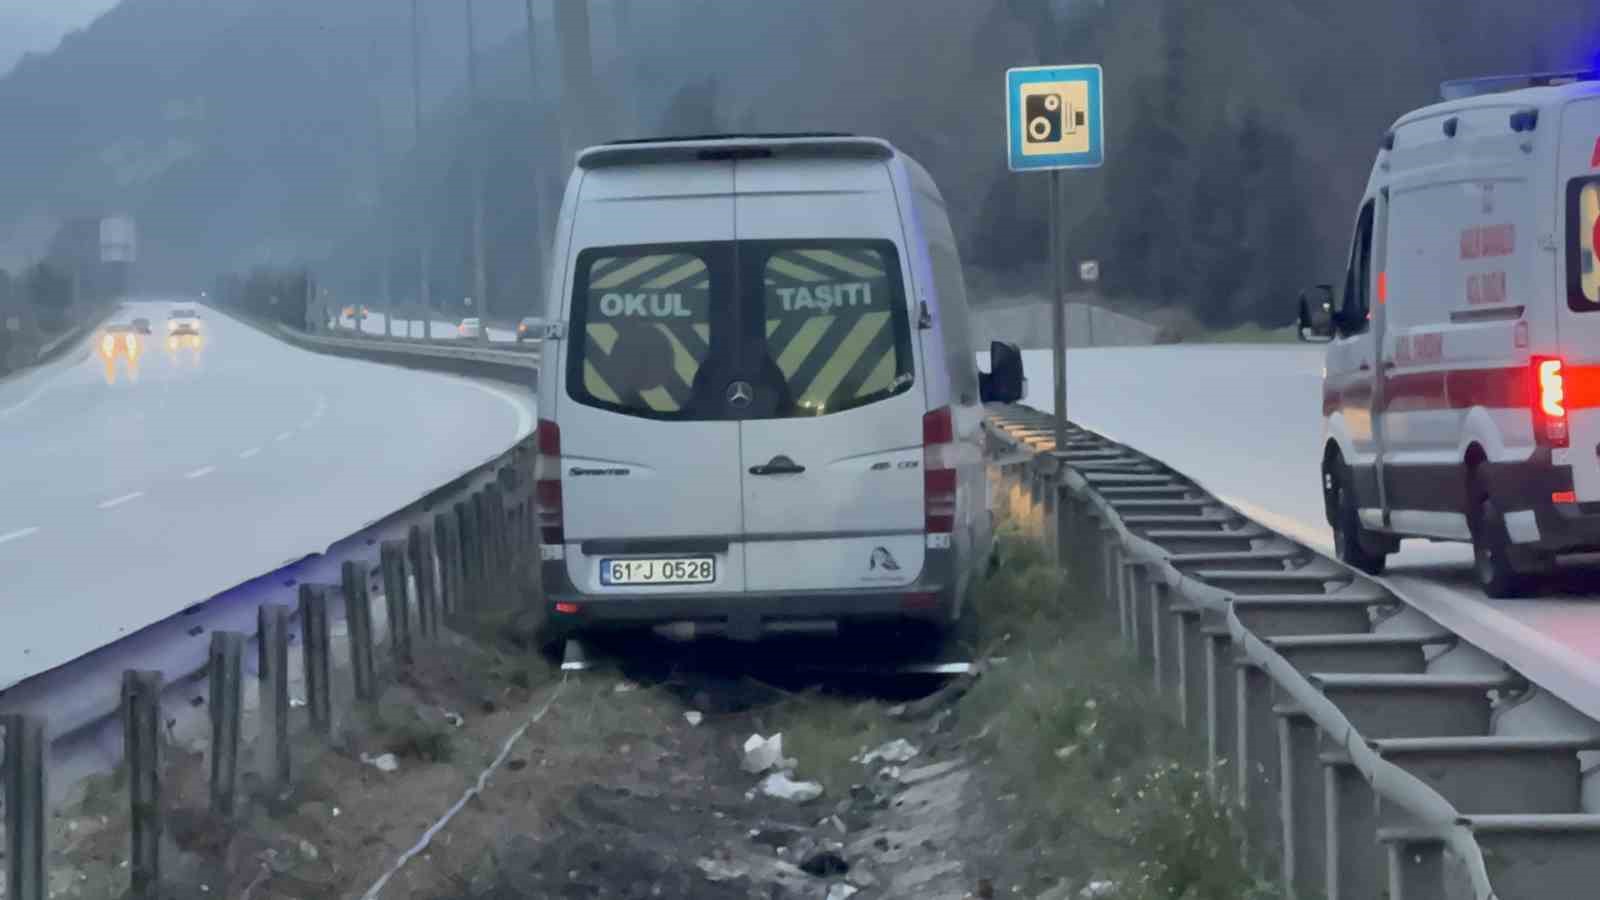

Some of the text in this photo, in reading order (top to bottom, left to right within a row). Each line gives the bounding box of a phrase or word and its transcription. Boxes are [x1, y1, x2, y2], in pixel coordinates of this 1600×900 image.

[599, 282, 872, 318] OKUL TAŞITI
[612, 560, 712, 580] 61 J 0528
